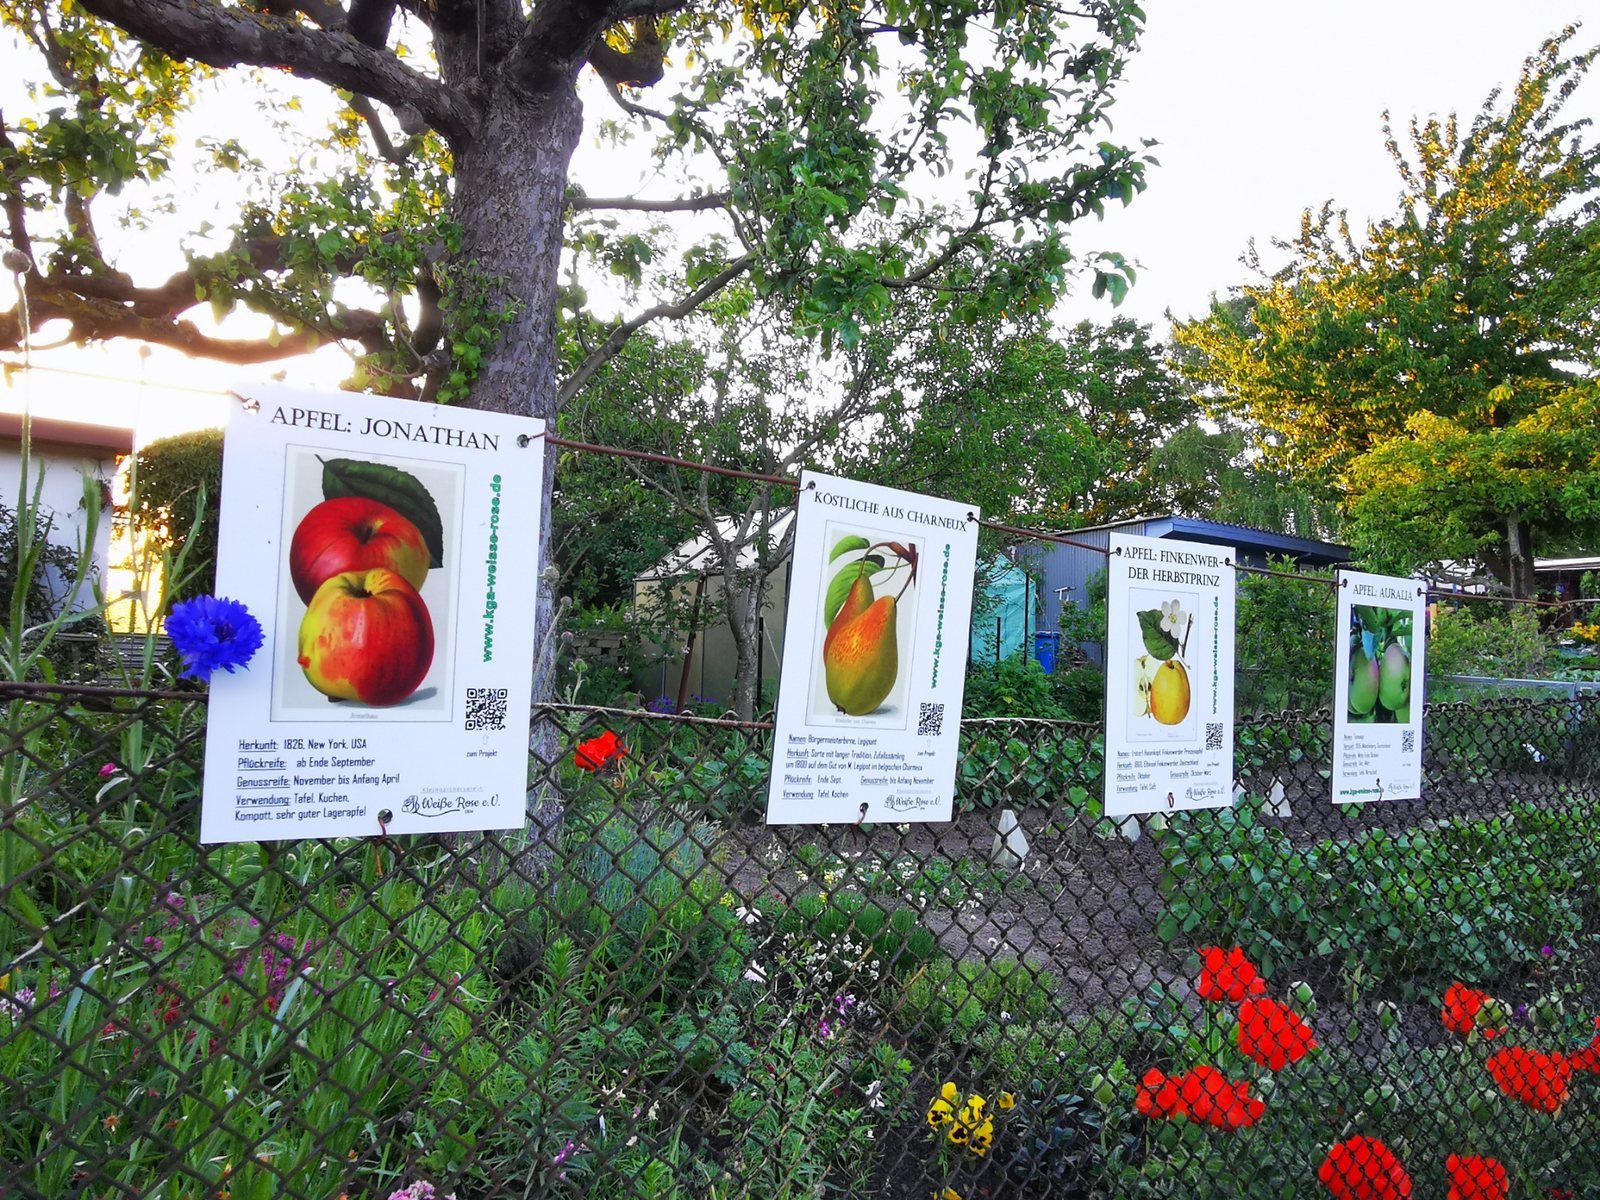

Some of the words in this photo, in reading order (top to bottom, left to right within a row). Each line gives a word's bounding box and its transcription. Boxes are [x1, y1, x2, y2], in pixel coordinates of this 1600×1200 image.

[270, 406, 352, 432] APFEL:
[360, 418, 500, 451] JONATHAN
[814, 491, 879, 515] KÖSTLICHE
[882, 506, 904, 520] AUS
[907, 510, 968, 532] CHARNEUX
[1124, 546, 1157, 560] APFEL:
[1160, 550, 1223, 568] FINKENWER-
[483, 474, 502, 662] www.kga-weisse-rose.de
[1128, 566, 1149, 580] DER
[1152, 569, 1220, 586] HERBSTPRINZ
[1353, 584, 1377, 597] APFEL:
[1380, 587, 1413, 601] AURALIA
[931, 543, 951, 689] www.kga-weisse-rose.de
[238, 739, 278, 752] Herkunft:
[308, 739, 325, 749] New
[351, 738, 367, 749] USA
[478, 749, 498, 758] Projekt
[811, 749, 824, 757] Sorte
[835, 750, 850, 759] langer
[238, 757, 287, 770] Pflückreife:
[296, 757, 306, 768] ab
[309, 757, 328, 768] Ende
[331, 756, 375, 769] September
[808, 760, 816, 768] auf
[817, 760, 827, 769] dem
[829, 761, 837, 769] Gut
[236, 776, 291, 788] Genussreife:
[294, 775, 336, 786] November
[338, 775, 350, 785] bis
[352, 774, 380, 786] Anfang
[381, 773, 400, 785] April
[818, 775, 829, 783] Ende
[236, 795, 291, 807] Verwendung:
[421, 796, 453, 810] Weiße
[455, 796, 480, 809] Rose
[276, 809, 295, 820] sehr
[298, 808, 321, 820] guter
[323, 806, 366, 820] Lagerapfel
